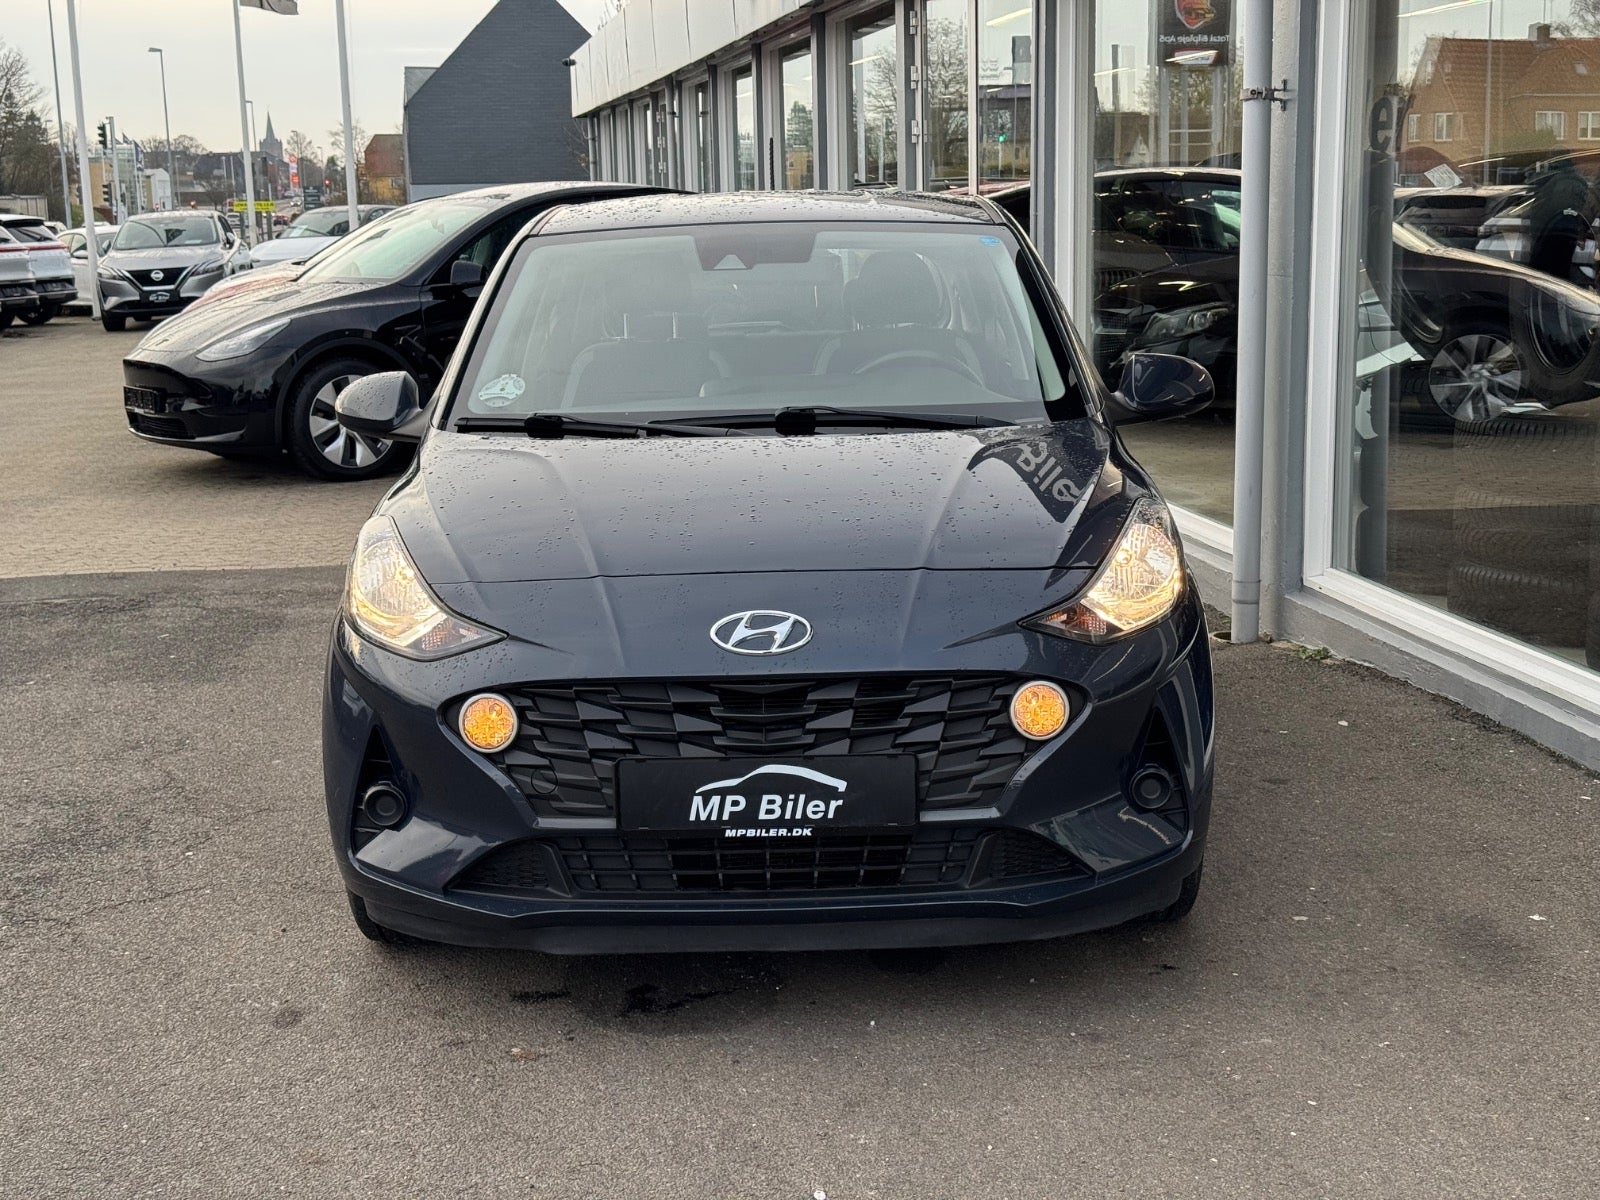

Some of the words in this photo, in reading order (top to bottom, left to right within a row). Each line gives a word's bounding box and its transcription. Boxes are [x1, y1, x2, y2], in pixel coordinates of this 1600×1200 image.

[689, 795, 746, 821] MP
[758, 793, 844, 820] Biler
[724, 827, 812, 838] MPBILER.DK
